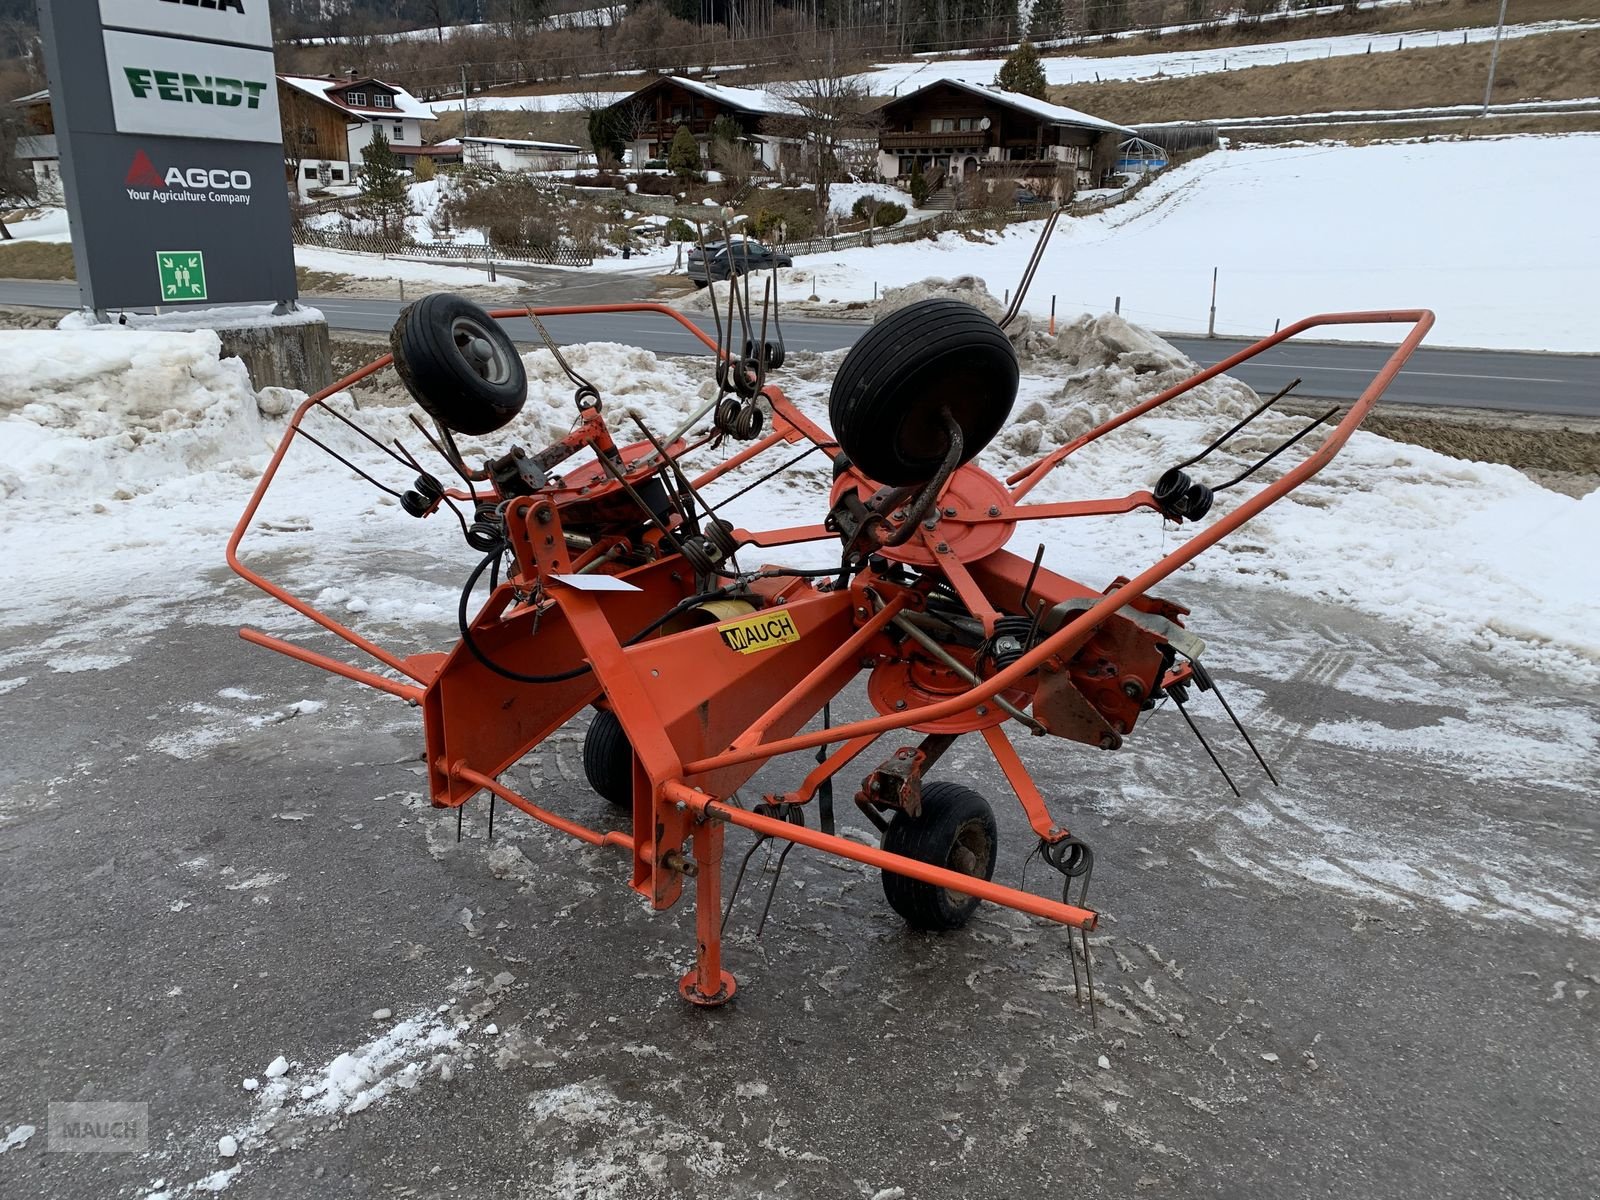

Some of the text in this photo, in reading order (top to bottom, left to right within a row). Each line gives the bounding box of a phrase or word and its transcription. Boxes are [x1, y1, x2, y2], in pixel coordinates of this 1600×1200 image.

[123, 66, 267, 109] FENDT
[164, 167, 252, 190] AGCO
[126, 188, 251, 206] Your Agriculture Company
[723, 617, 795, 651] MAUCH
